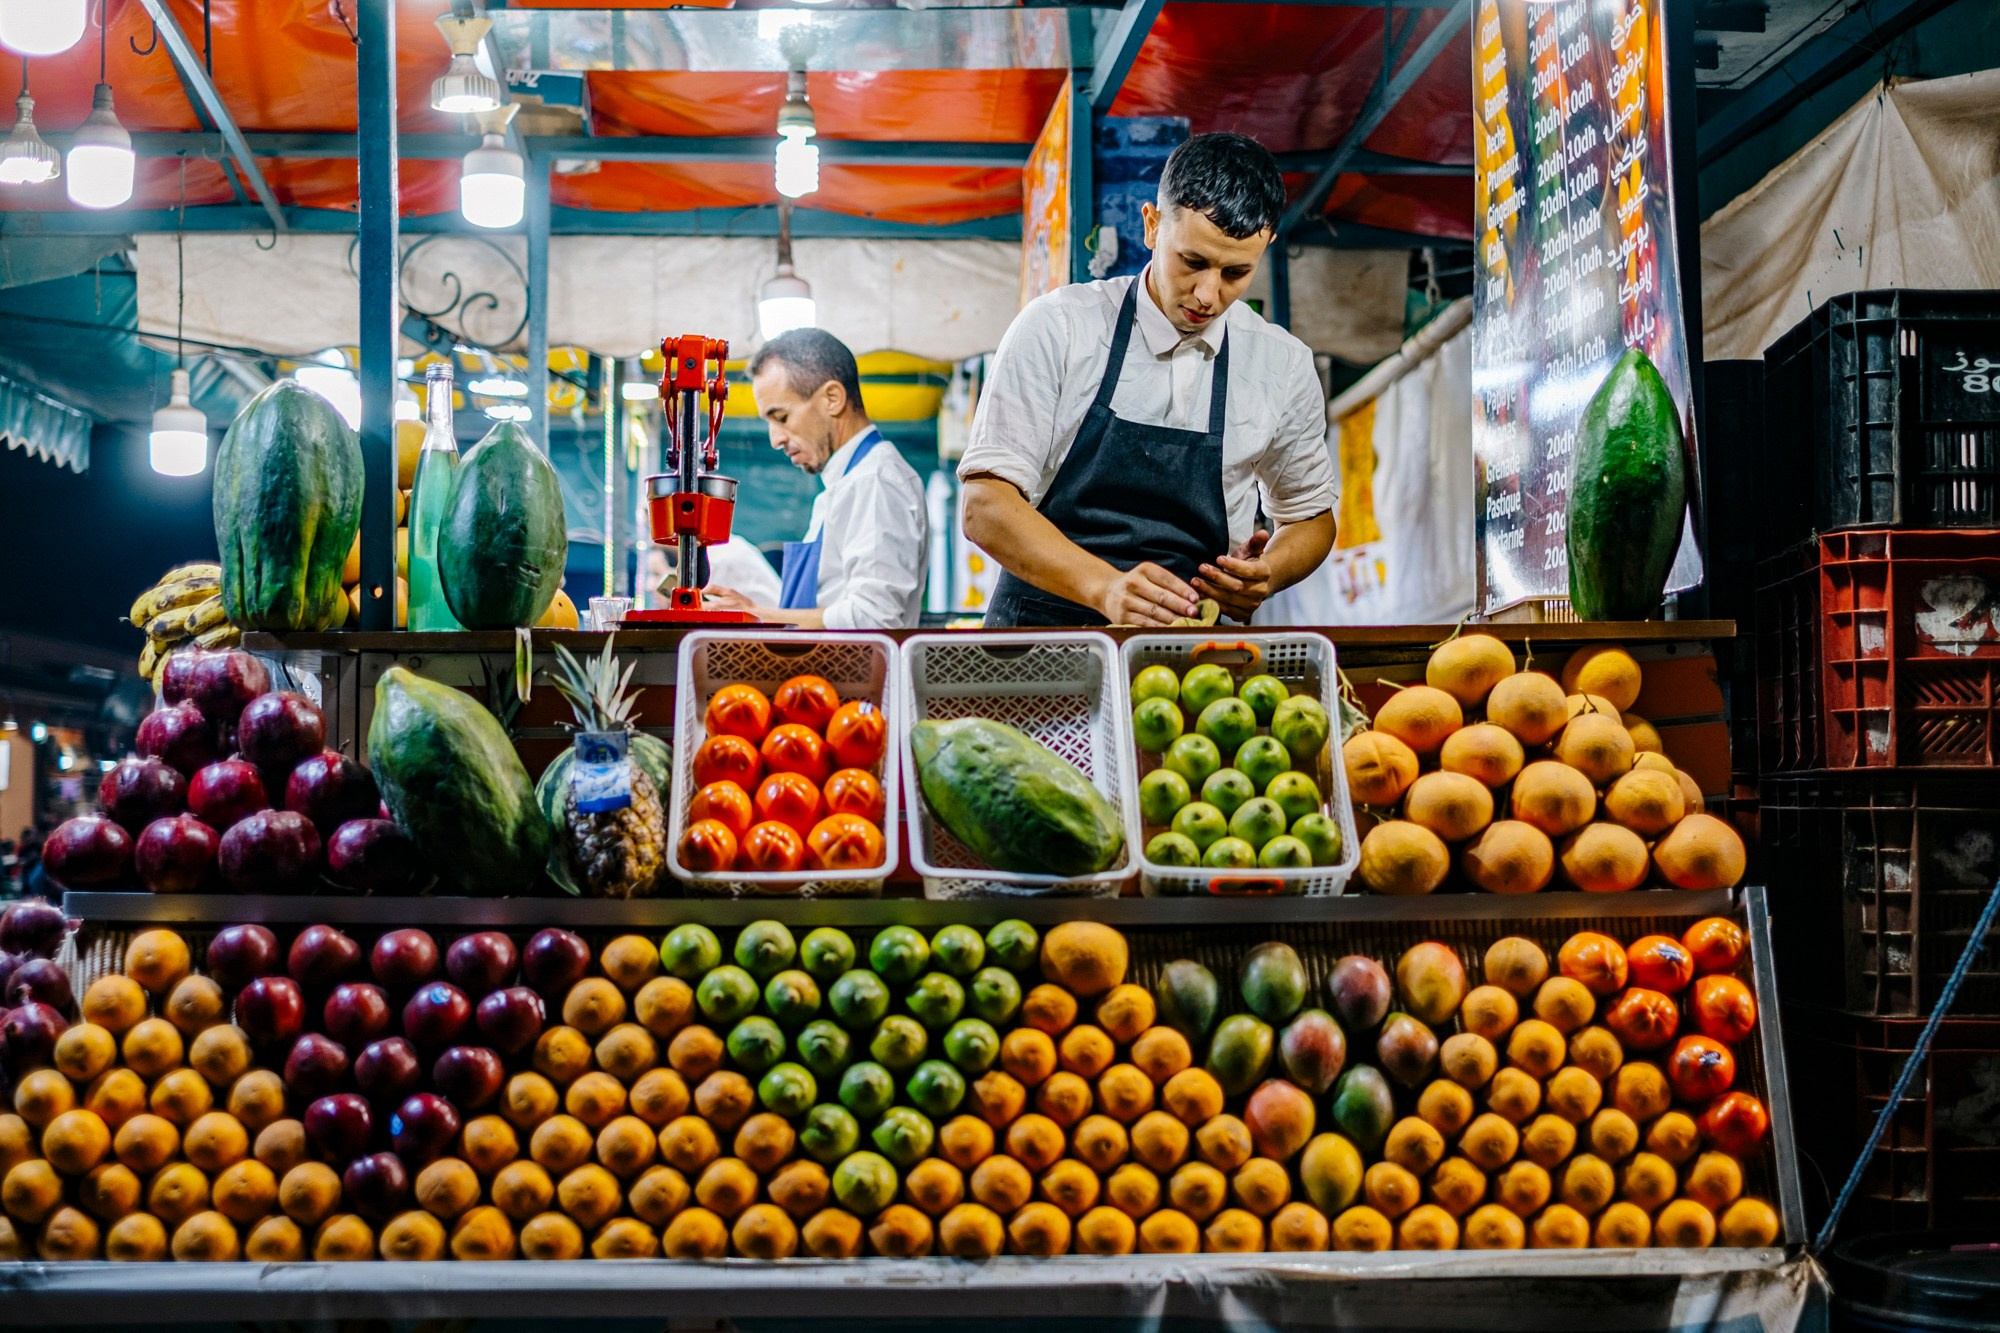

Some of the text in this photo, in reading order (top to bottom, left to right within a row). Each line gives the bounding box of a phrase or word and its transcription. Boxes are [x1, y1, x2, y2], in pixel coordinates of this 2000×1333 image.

[1529, 23, 1556, 64] 20dh
[1561, 32, 1590, 73] 10dh
[1483, 47, 1507, 87] Pomme
[1532, 60, 1558, 100] 20dh
[1607, 47, 1644, 99] برقوق
[1484, 84, 1509, 123] Banane
[1564, 79, 1593, 118] 10dh
[1603, 81, 1645, 143] زنجبيل
[1534, 102, 1561, 145] 20dh
[1566, 125, 1597, 164] 10dh
[1611, 130, 1646, 186] كاكي
[1487, 152, 1520, 195] Pruneaux
[1537, 149, 1565, 188] 20dh
[1569, 162, 1599, 200] 10dh
[1487, 186, 1526, 229] Gingembre
[1539, 186, 1567, 223] 20dh
[1617, 176, 1649, 224] كيوي
[1572, 208, 1601, 245] 10dh
[1487, 234, 1504, 268] Kaki
[1542, 230, 1570, 266] 20dh
[1574, 244, 1603, 281] 10dh
[1487, 271, 1505, 304] Kiwi
[1543, 265, 1571, 300] 20dh
[1545, 305, 1573, 340] 20dh
[1546, 352, 1574, 382] 20dh
[1578, 334, 1606, 369] 10dh
[1487, 383, 1516, 415] Papaye
[1547, 429, 1575, 460] 20dh
[1486, 453, 1520, 483] Grenade
[1546, 466, 1568, 495] 20d
[1486, 490, 1521, 520] Pastique
[1545, 510, 1566, 535] 20d
[1544, 543, 1567, 570] 20d
